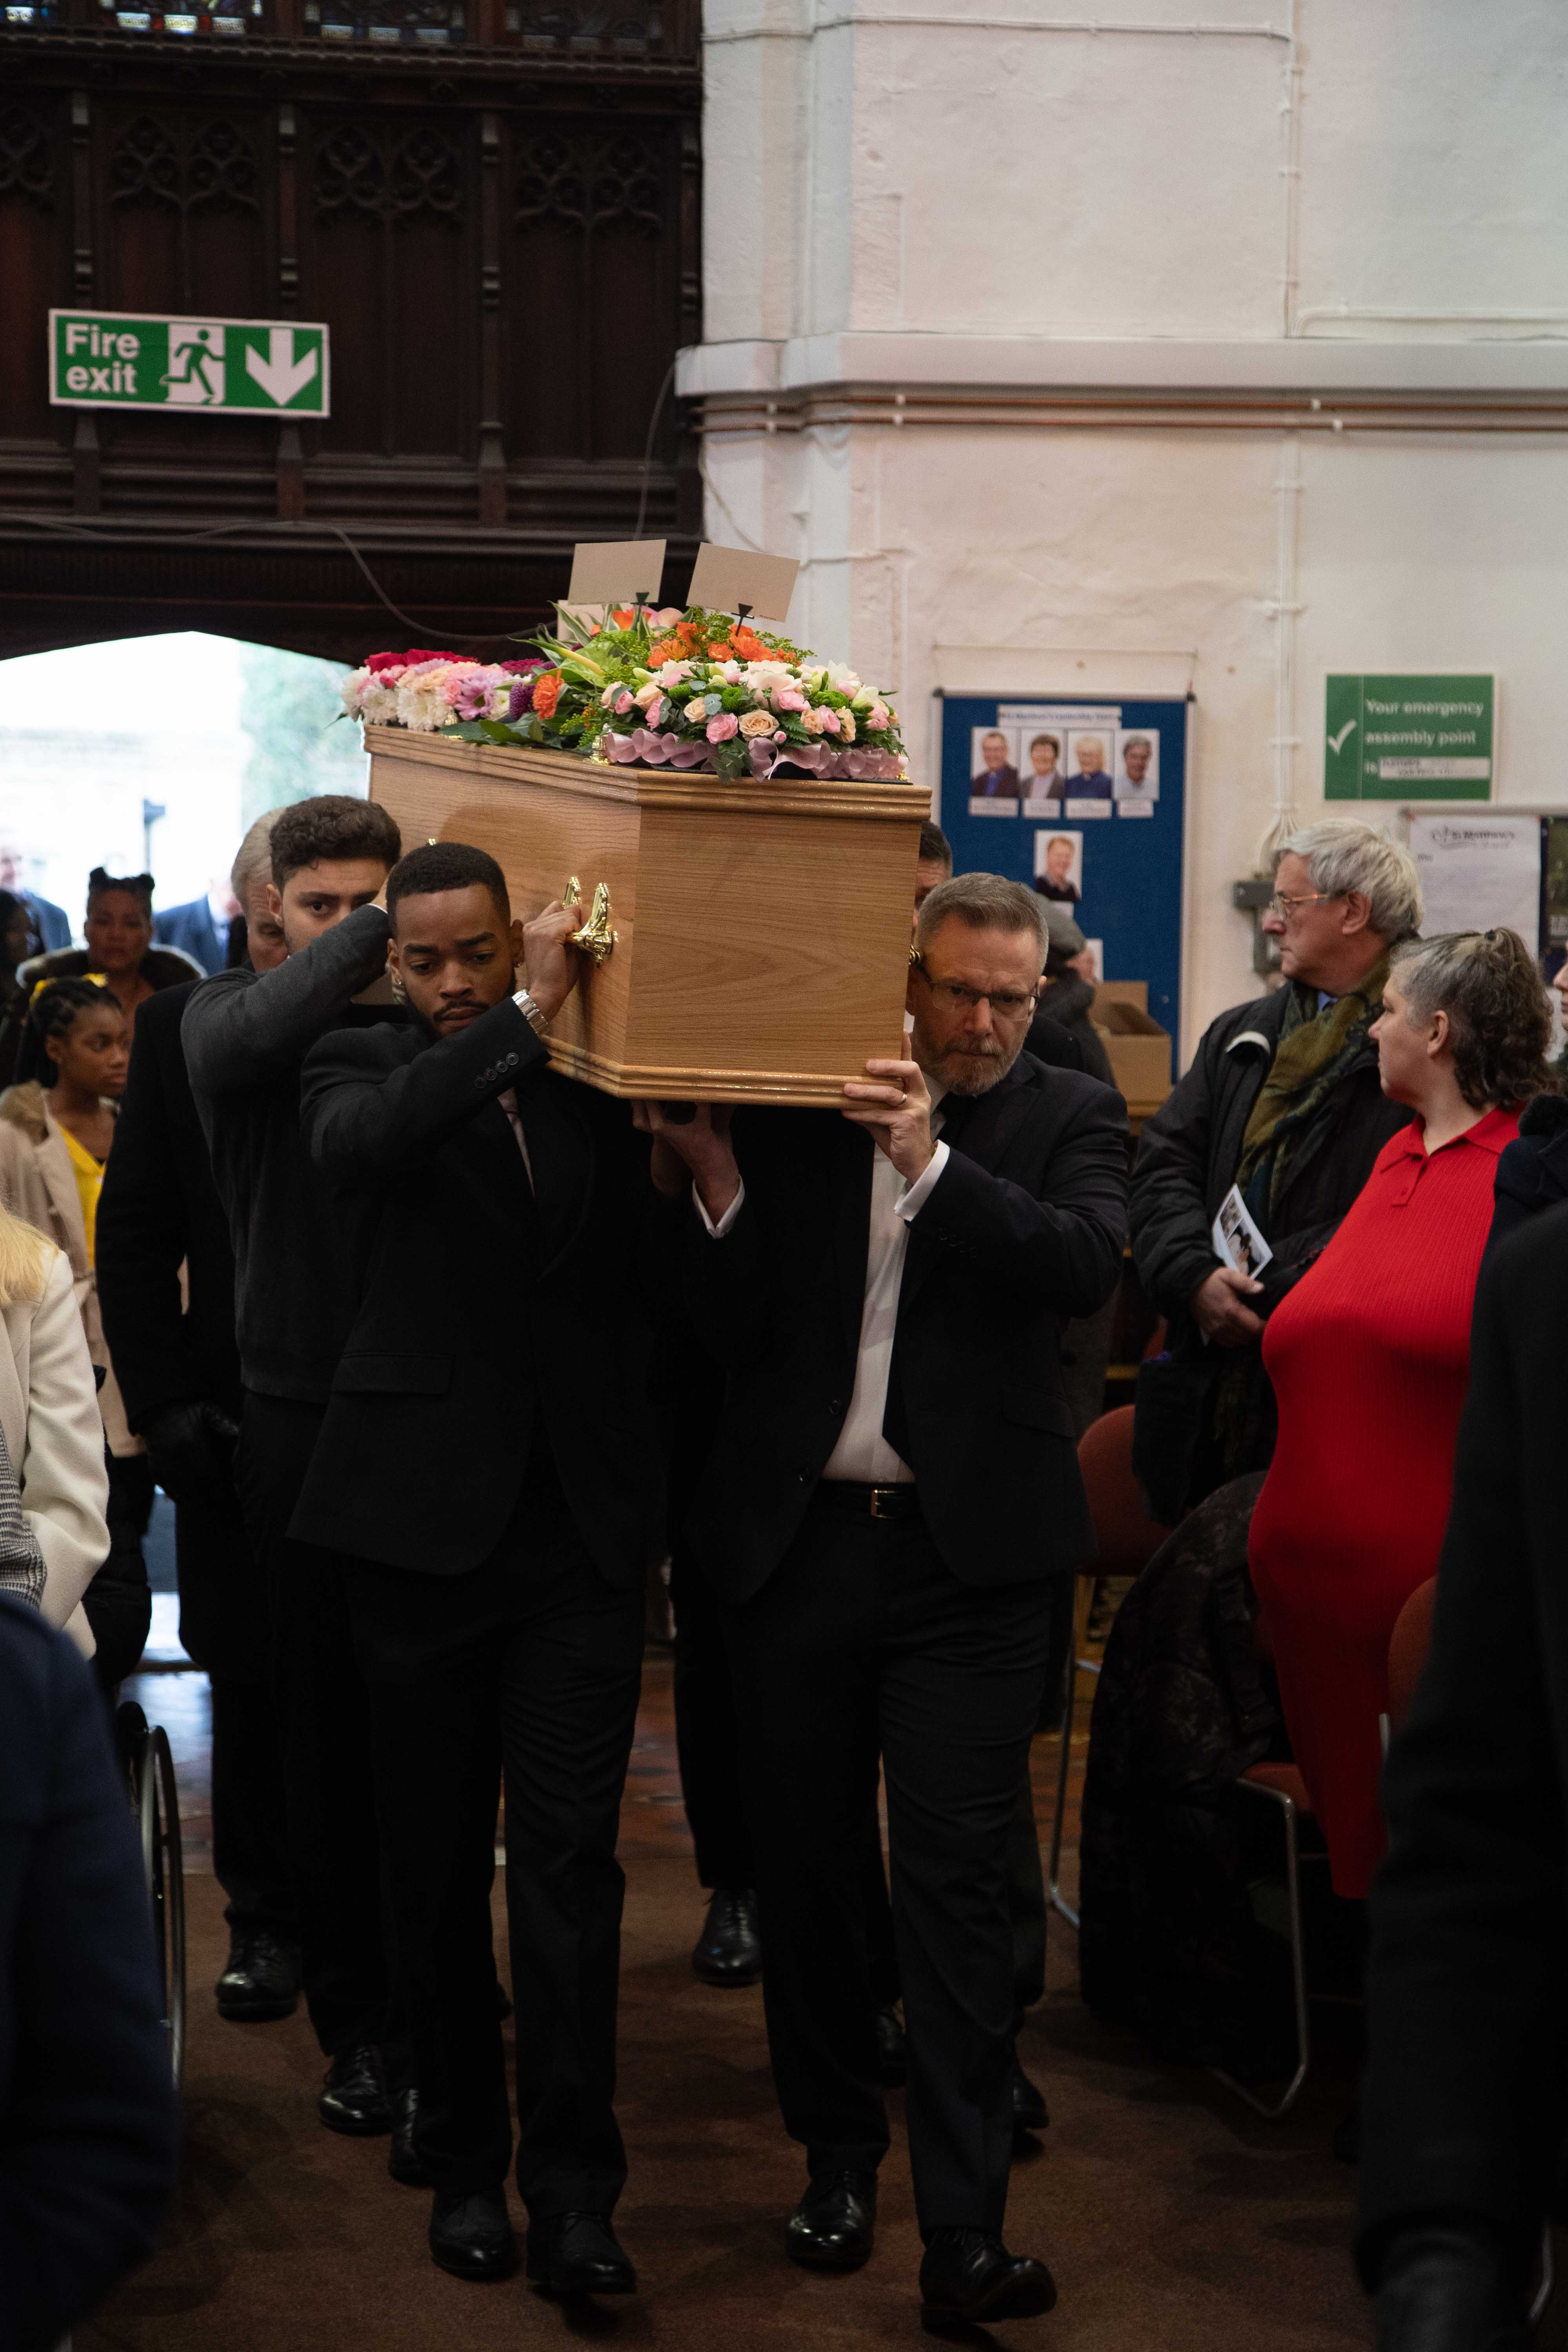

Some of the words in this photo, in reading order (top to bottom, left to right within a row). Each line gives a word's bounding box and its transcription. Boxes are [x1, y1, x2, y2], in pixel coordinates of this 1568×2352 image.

[66, 323, 140, 359] Fire
[66, 361, 137, 394] exit
[1366, 700, 1399, 714] Your
[1402, 702, 1484, 717] emergency
[1366, 730, 1436, 746] assembly
[1437, 730, 1476, 746] point
